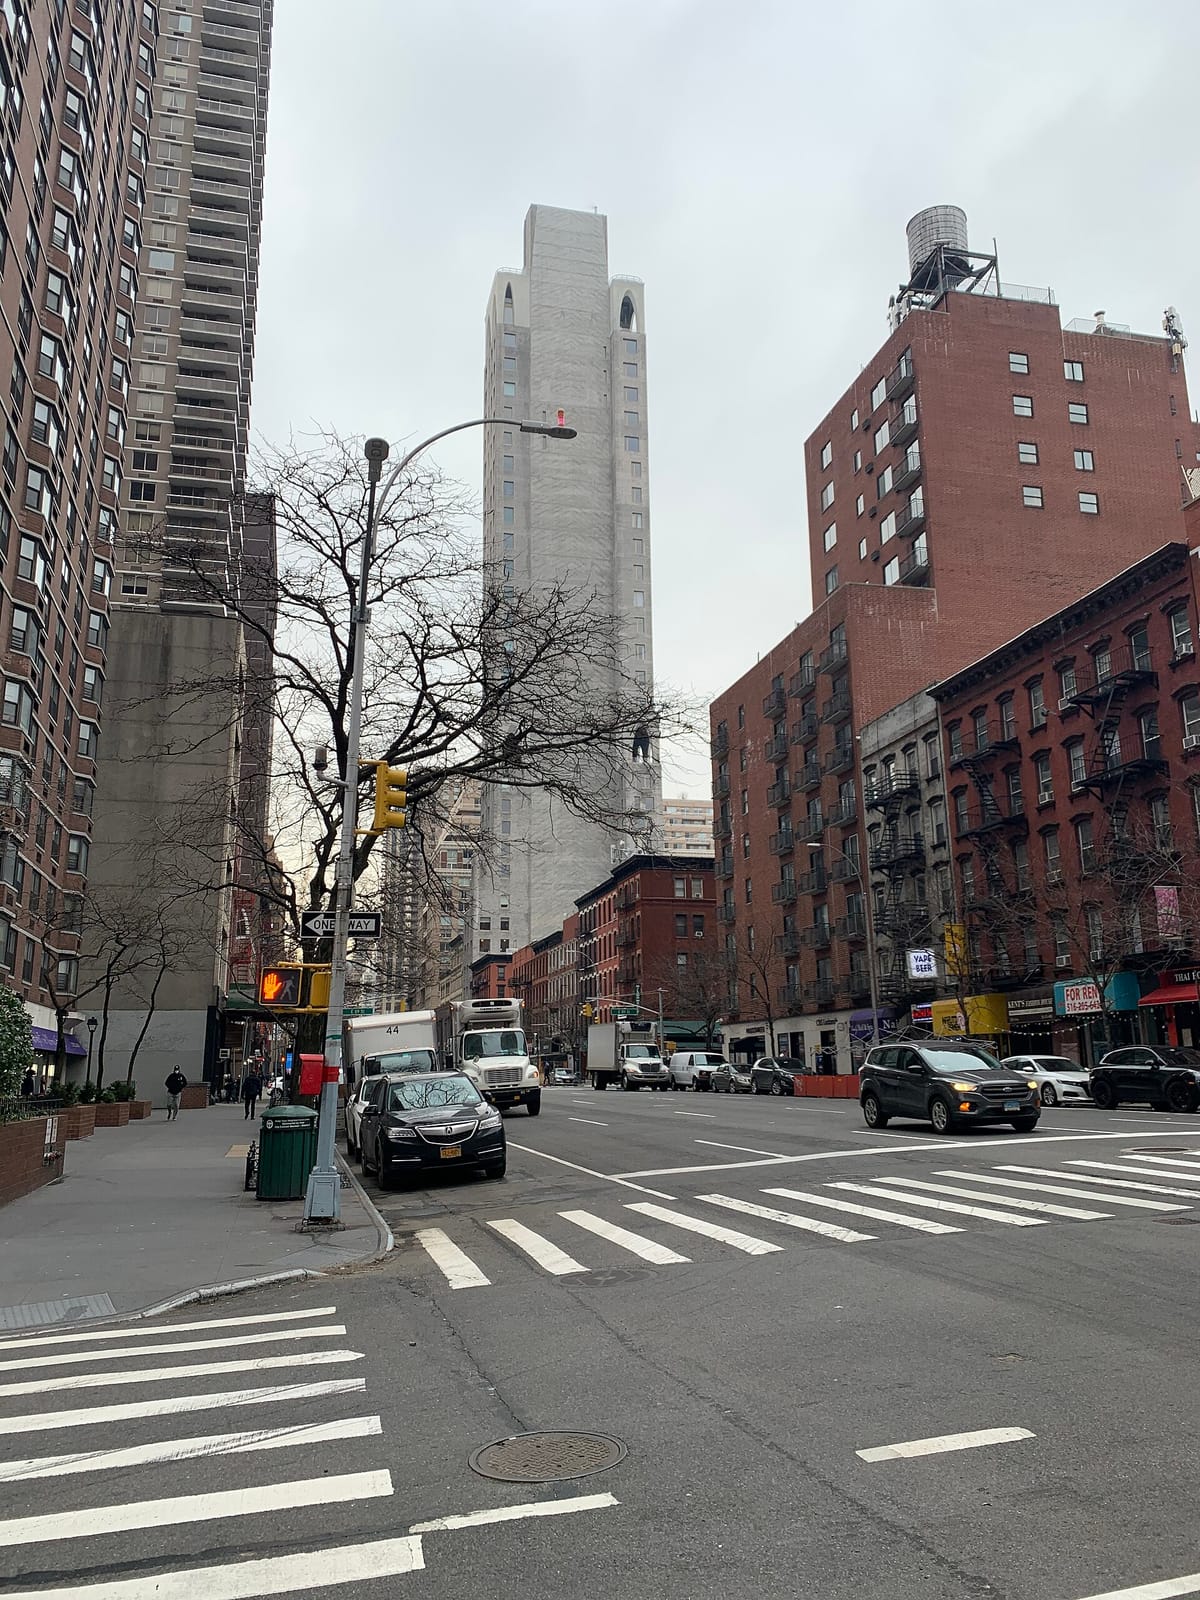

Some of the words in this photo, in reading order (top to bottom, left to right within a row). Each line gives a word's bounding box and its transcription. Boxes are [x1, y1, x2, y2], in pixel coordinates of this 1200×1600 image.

[313, 919, 335, 930] ONE
[348, 919, 371, 930] WAY
[913, 953, 932, 963] VAPE
[915, 964, 933, 973] BEER
[1174, 971, 1190, 982] THAI
[1065, 988, 1081, 1002] FOR
[1082, 985, 1098, 1000] REN
[386, 1026, 399, 1035] 44
